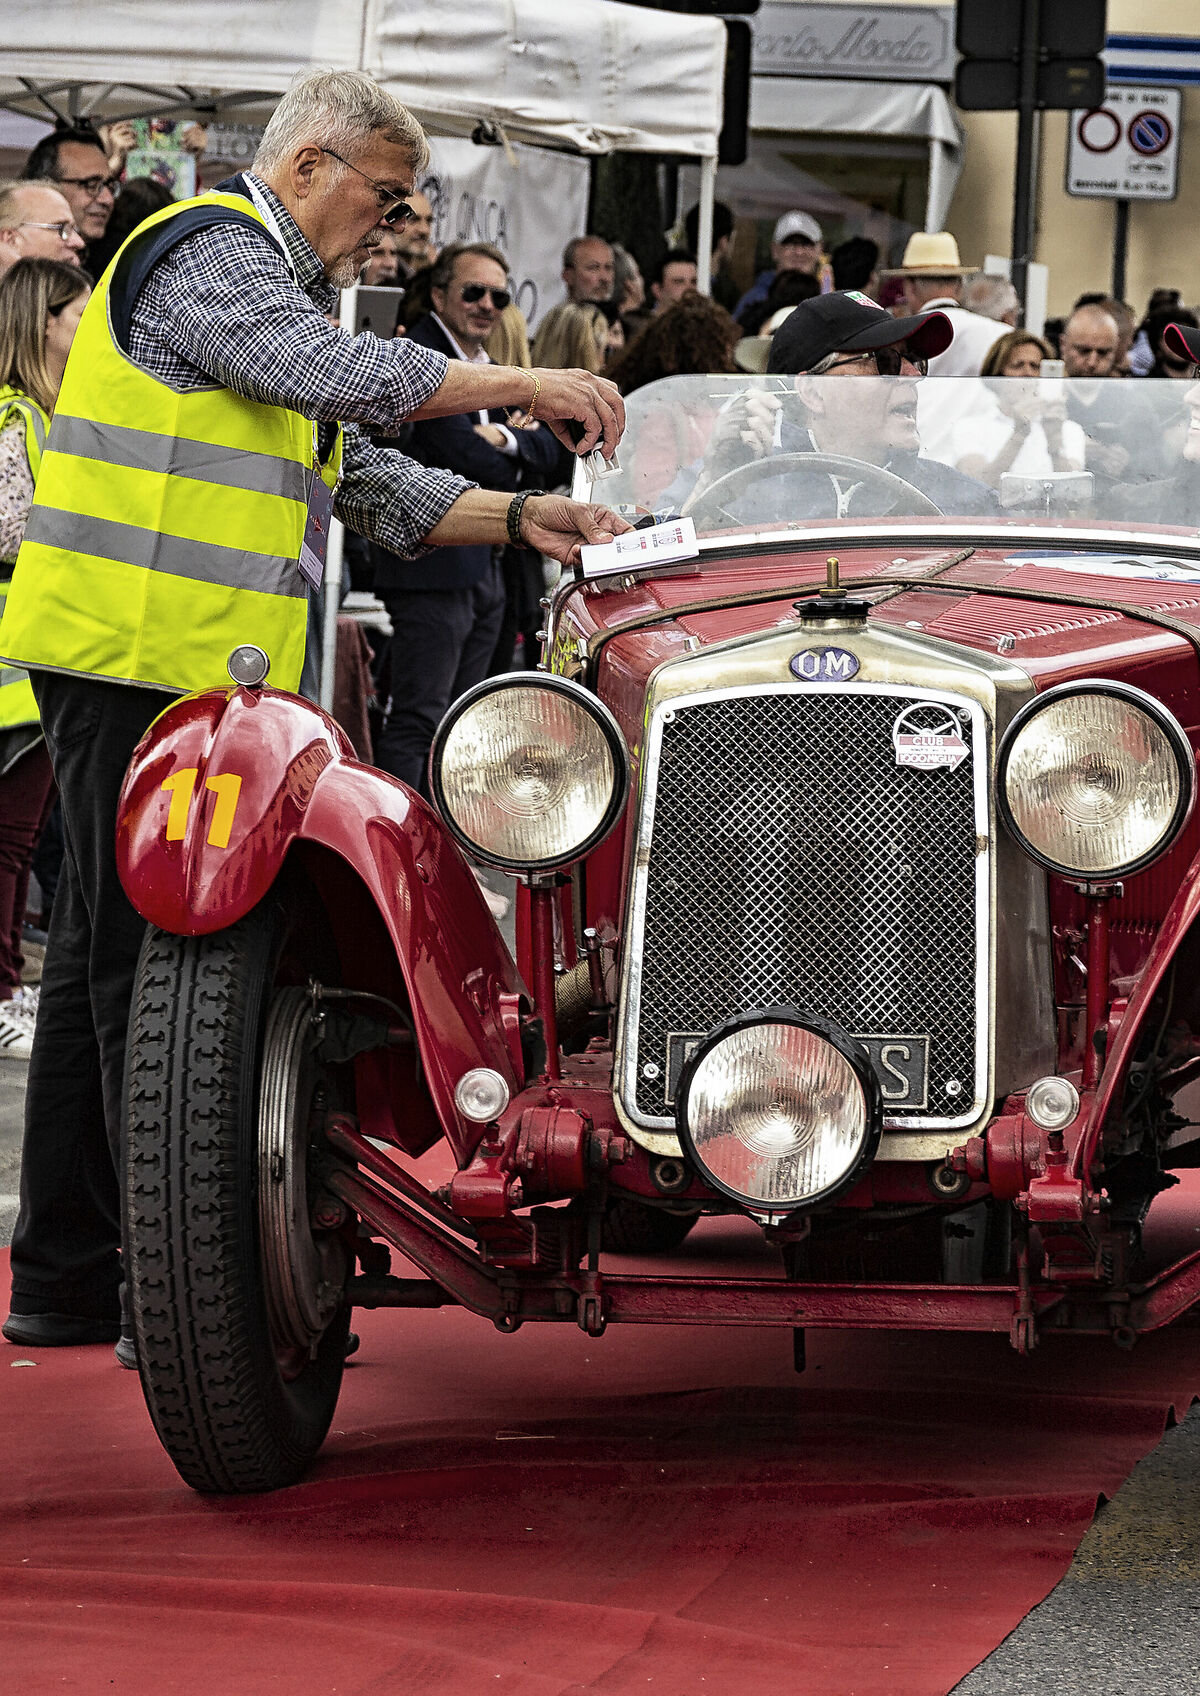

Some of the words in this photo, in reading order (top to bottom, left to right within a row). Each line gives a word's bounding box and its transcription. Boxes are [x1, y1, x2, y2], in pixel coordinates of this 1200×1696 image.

[798, 650, 851, 678] OM
[912, 736, 944, 746] CLUB
[161, 767, 243, 849] 11
